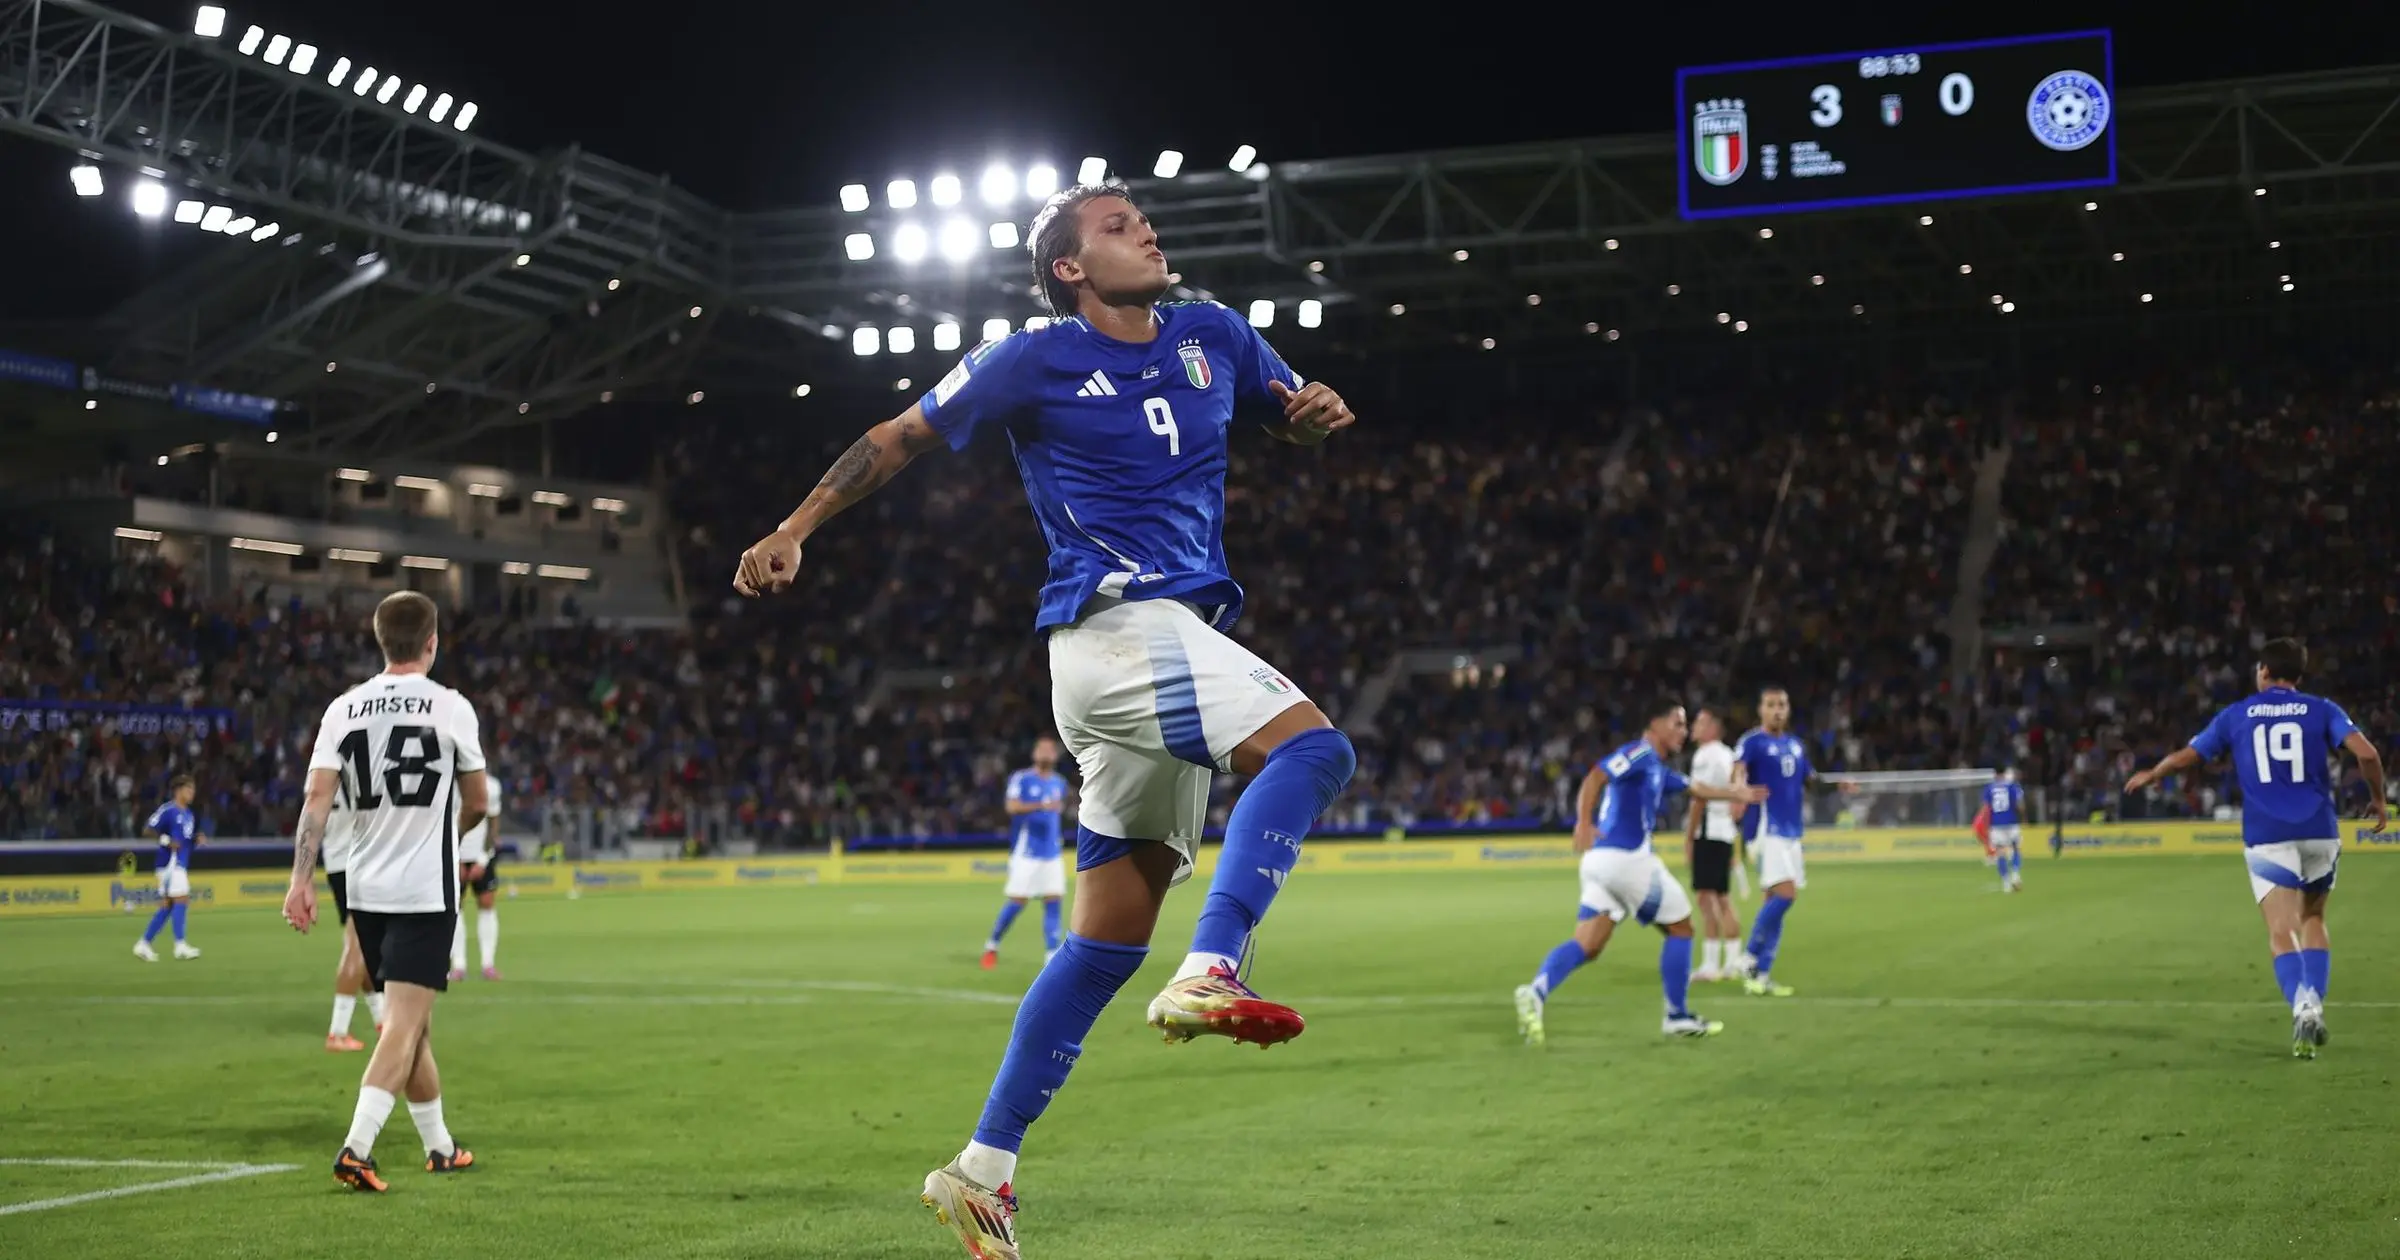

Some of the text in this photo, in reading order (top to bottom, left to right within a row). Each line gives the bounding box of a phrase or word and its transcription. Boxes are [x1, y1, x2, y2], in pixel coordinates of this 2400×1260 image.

[1810, 84, 1843, 127] 3
[1939, 72, 1974, 116] 0
[1181, 348, 1203, 359] ITALIA
[1143, 397, 1180, 456] 9
[348, 698, 433, 720] LARSEN
[2247, 703, 2308, 717] CAMBIASO
[337, 726, 442, 809] 18
[2253, 722, 2304, 783] 19
